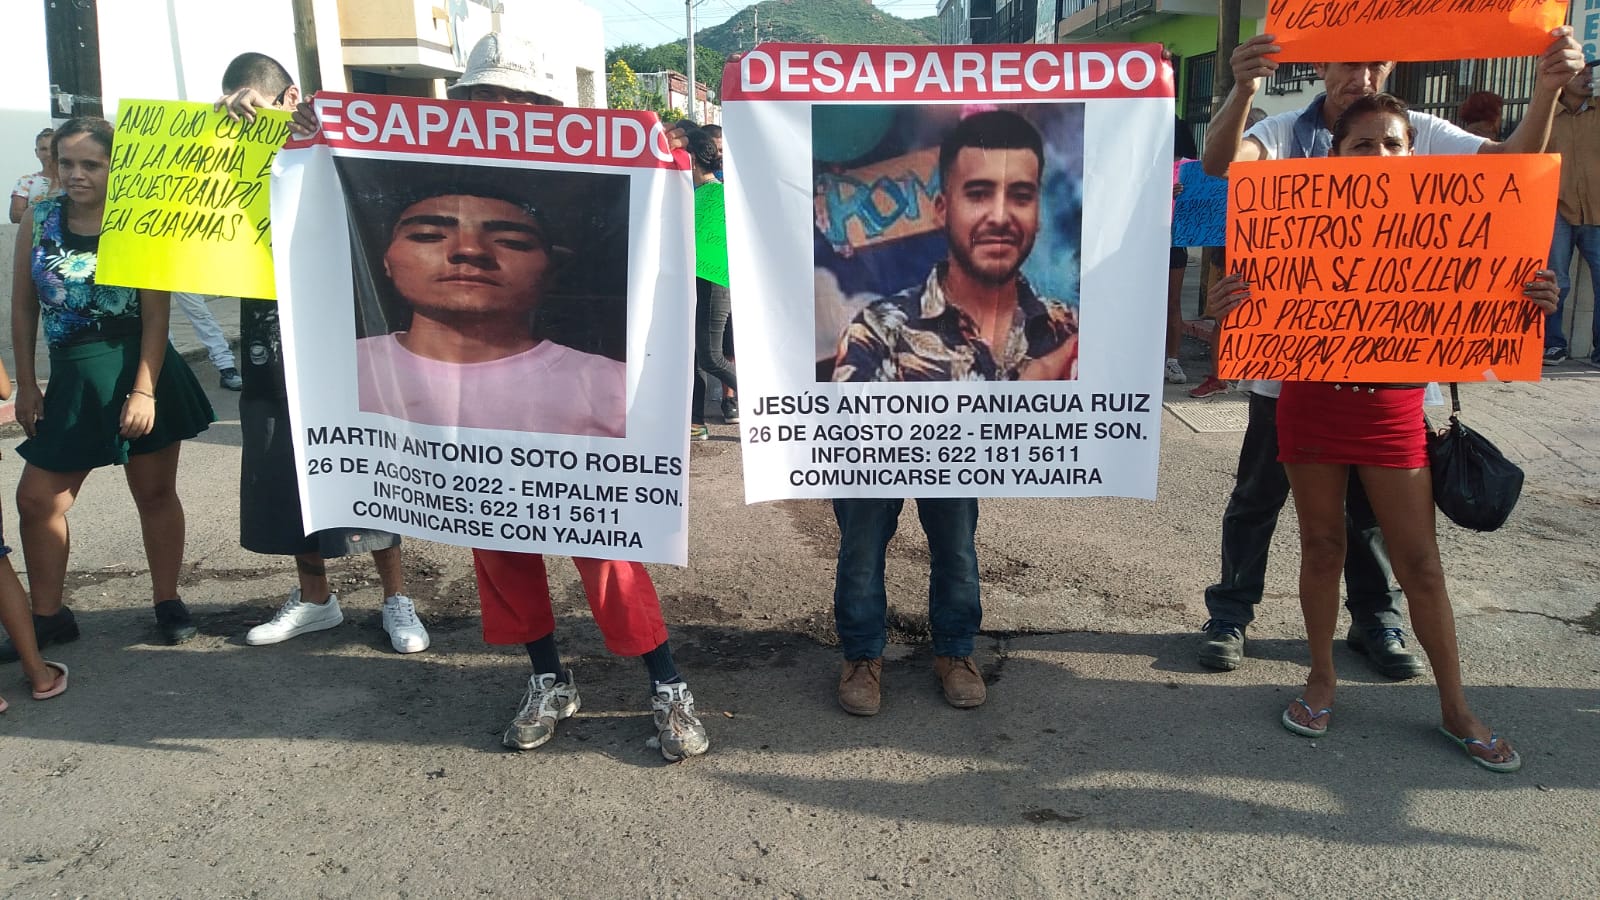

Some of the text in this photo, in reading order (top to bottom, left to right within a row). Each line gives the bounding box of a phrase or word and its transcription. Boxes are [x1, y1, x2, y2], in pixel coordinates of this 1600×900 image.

[1286, 0, 1359, 30] JESUS
[741, 50, 1156, 93] DESAPARECIDO
[118, 105, 165, 136] AMLO
[170, 109, 206, 138] OJO
[293, 97, 674, 163] ESAPARECIDO
[109, 142, 139, 173] EN
[139, 143, 167, 172] LA
[166, 142, 245, 178] MARINA
[108, 173, 263, 210] SECUESTRANDO
[1234, 172, 1390, 214] QUEREMOS
[1410, 172, 1485, 206] VIVOS
[1499, 172, 1522, 204] A
[101, 207, 133, 236] EN
[133, 209, 243, 242] GUAYMAS
[1234, 212, 1492, 254] NUESTROS HIJOS LA
[1230, 256, 1323, 294] MARINA
[1332, 256, 1365, 293] SE
[1365, 256, 1412, 293] LOS
[1412, 256, 1482, 293] LLEVO
[1487, 256, 1507, 293] Y
[1274, 298, 1445, 336] PRESENTARON
[1441, 300, 1462, 336] A
[1461, 300, 1542, 339] NINGUNA
[1220, 333, 1345, 364] AUTORIDAD
[1342, 335, 1429, 364] PORQUE
[1427, 336, 1464, 367] NO
[753, 391, 1151, 416] JESÚS ANTONIO PANIAGUA RUIZ
[749, 426, 771, 443] 26
[778, 425, 806, 441] DE
[813, 424, 903, 441] AGOSTO
[910, 424, 961, 440] 2022
[981, 424, 1088, 440] EMPALME
[1094, 423, 1148, 440] SON.
[307, 427, 682, 477] MARTIN ANTONIO SOTO ROBLES
[812, 446, 1079, 463] INFORMES: 622 181 5611
[308, 458, 333, 476] 26
[340, 458, 369, 474] DE
[375, 461, 446, 490] AGOSTO
[453, 475, 503, 495] 2022
[521, 481, 628, 503] EMPALME
[635, 487, 683, 507] SON.
[790, 468, 1102, 486] COMUNICARSE CON YAJAIRA
[373, 481, 619, 524] INFORMES: 622 181 5611
[352, 501, 644, 548] COMUNICARSE CON YAJAIRA
